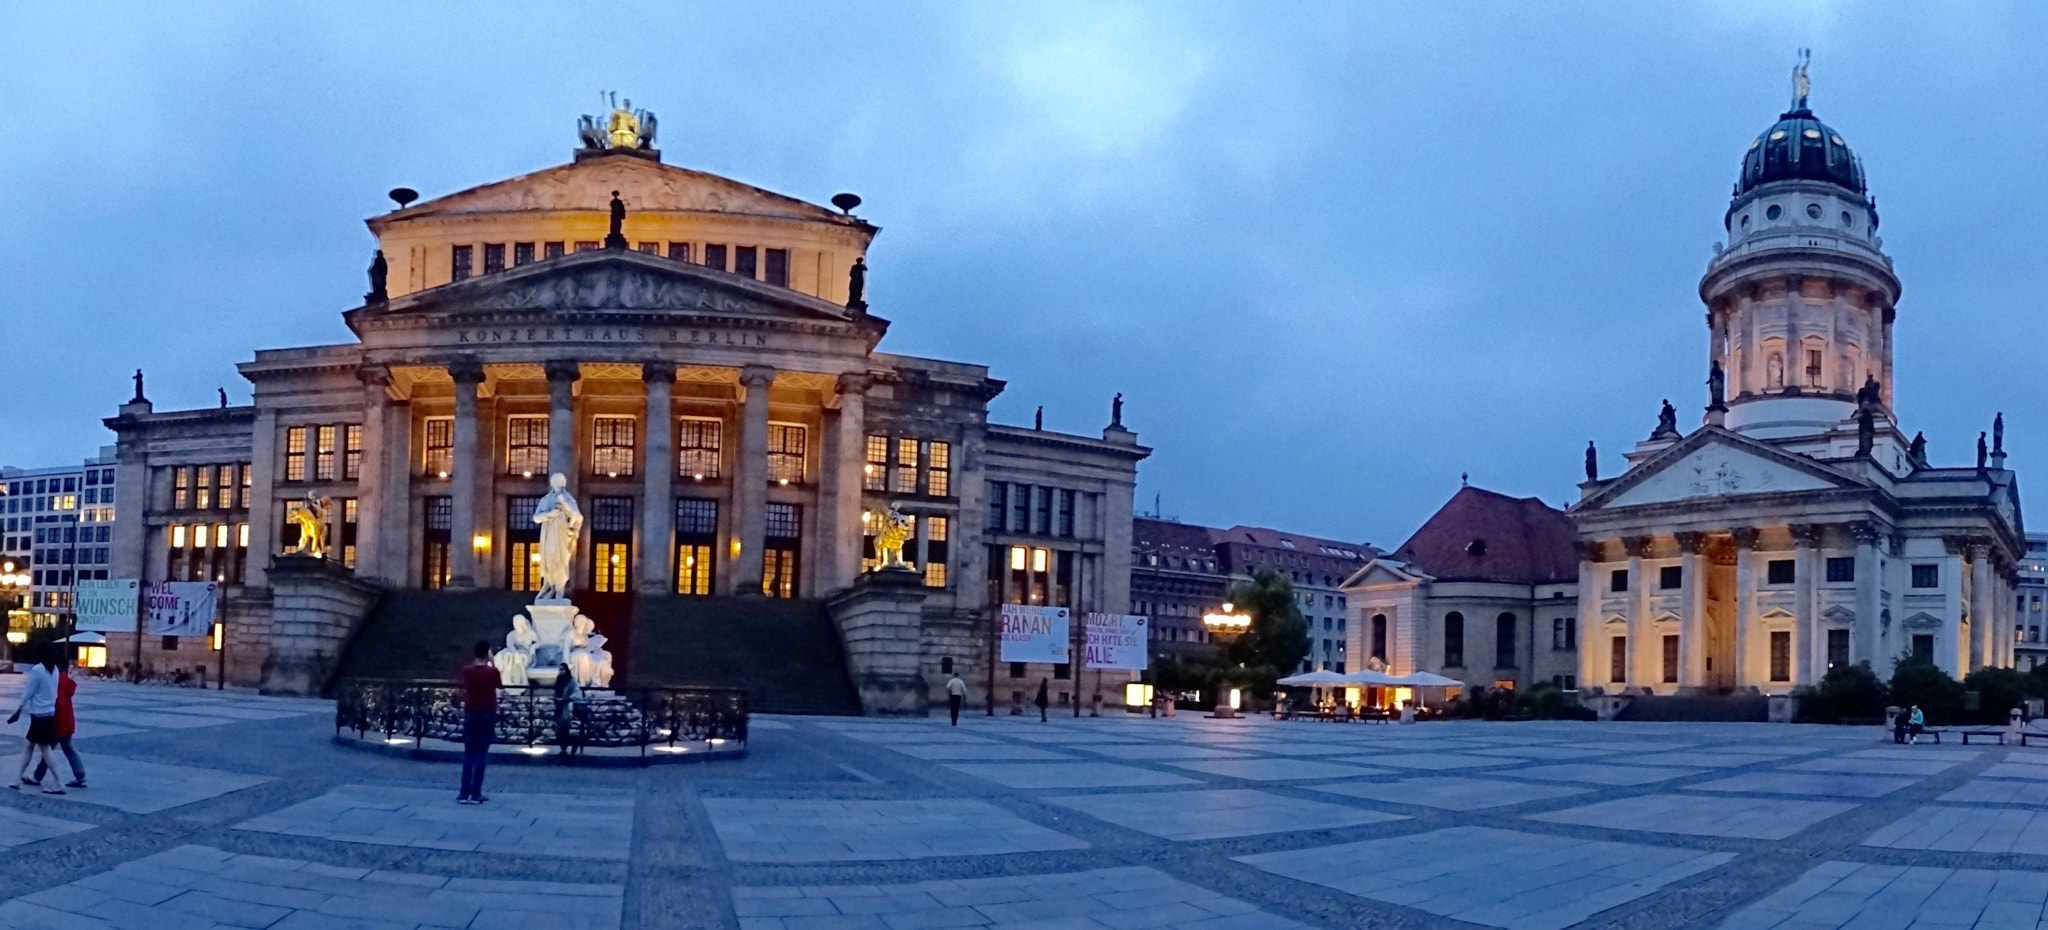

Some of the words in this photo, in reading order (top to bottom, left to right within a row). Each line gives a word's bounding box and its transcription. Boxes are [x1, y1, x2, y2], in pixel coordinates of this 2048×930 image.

[459, 328, 645, 344] KONZERTHAUS
[668, 329, 767, 346] BERLIN
[151, 580, 174, 595] WEL
[77, 598, 135, 616] WUNSCH
[149, 596, 181, 610] COME
